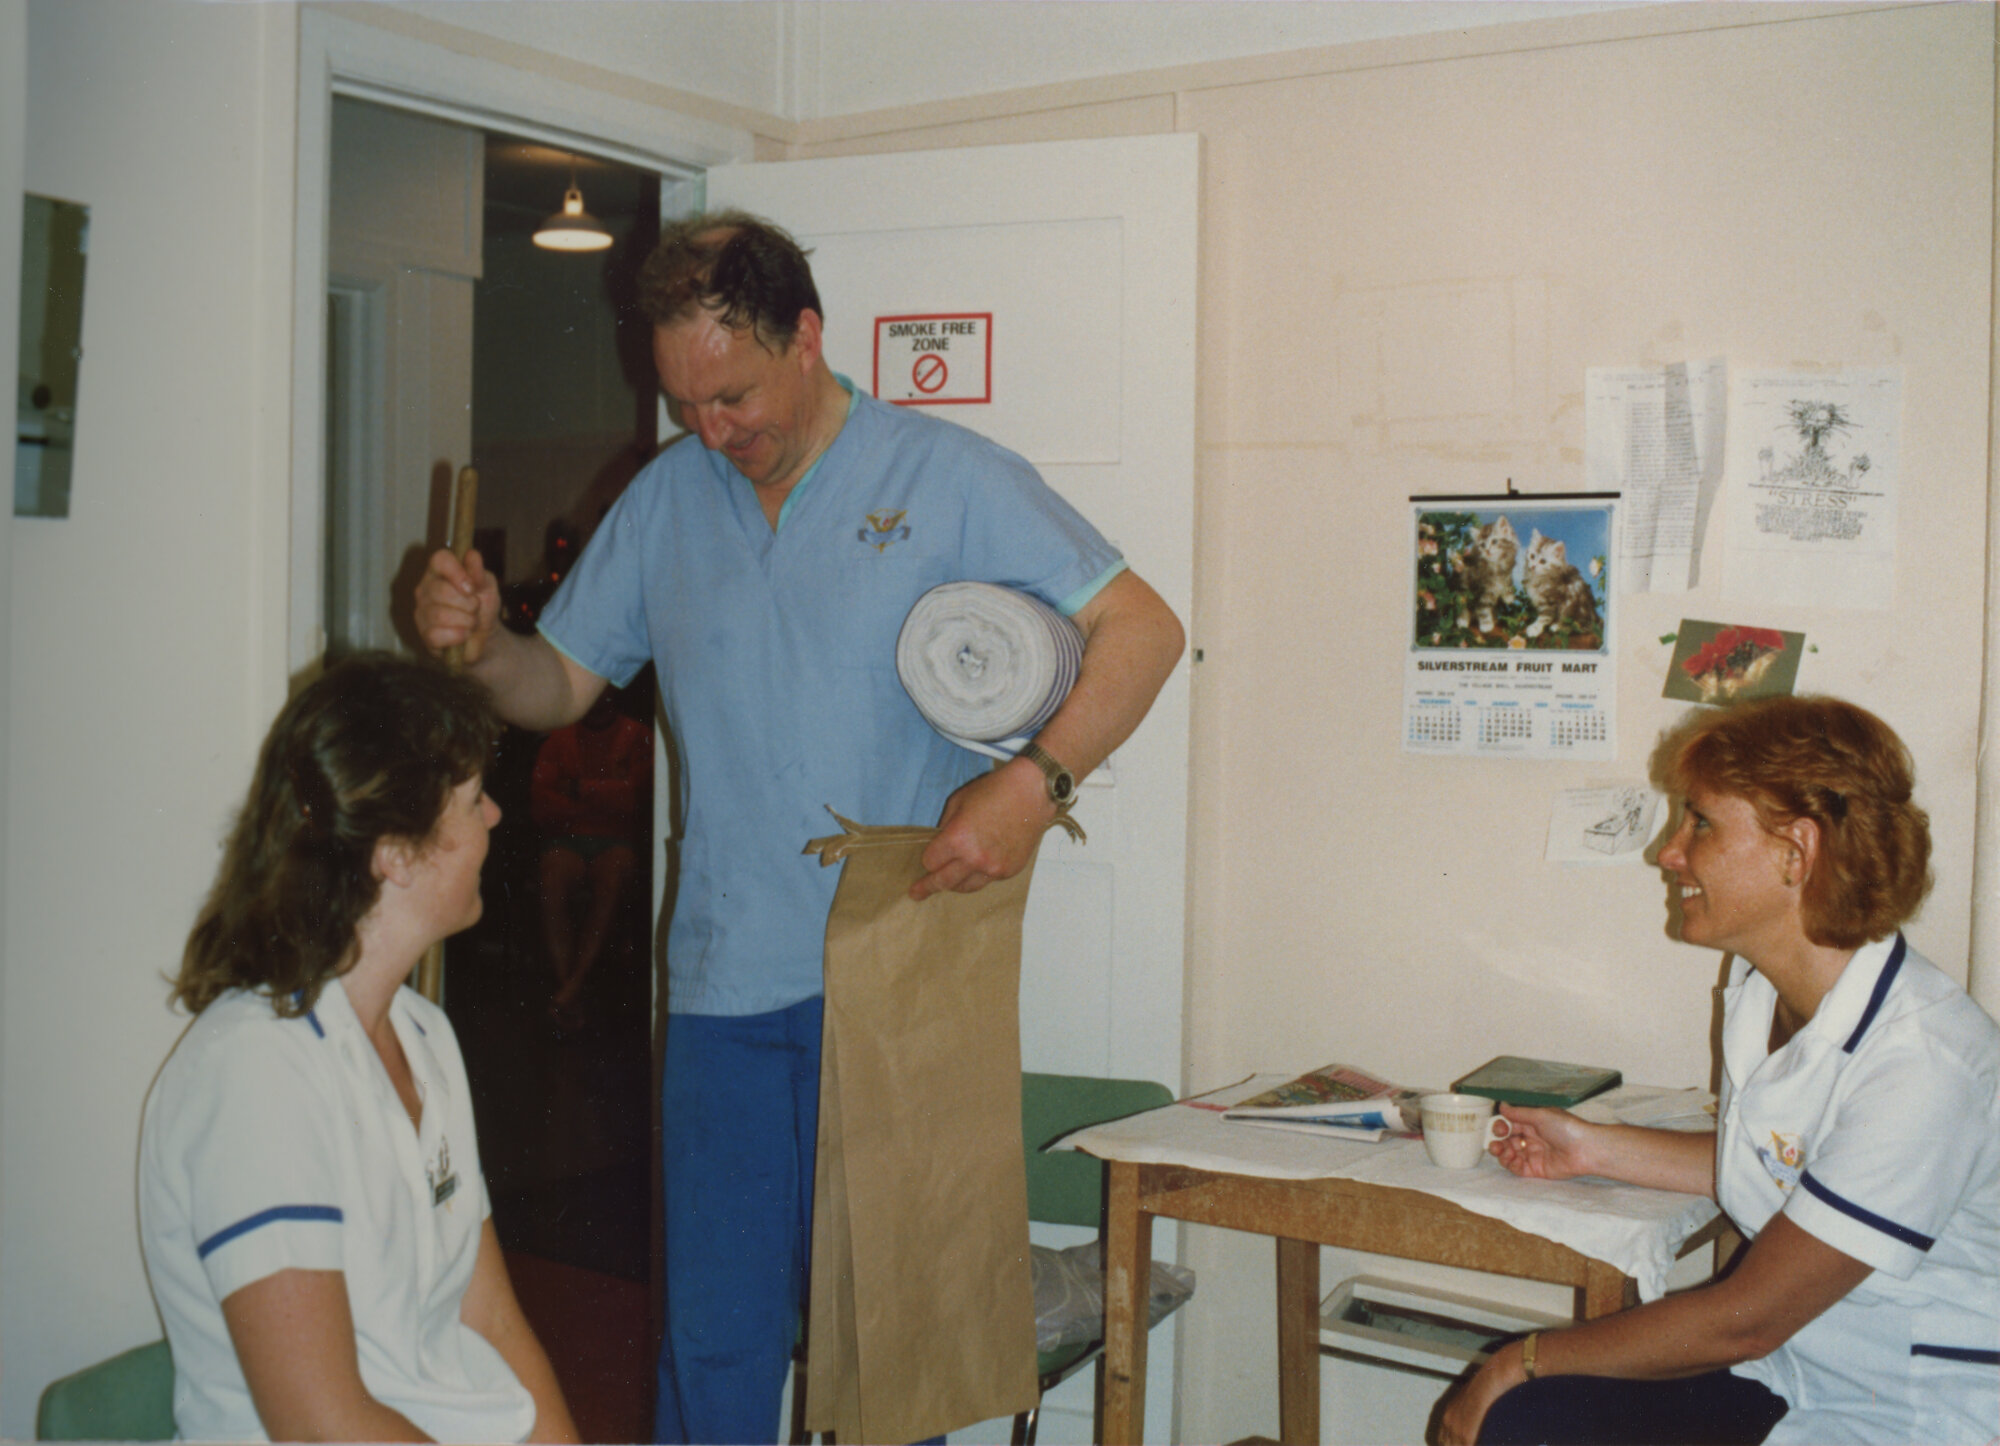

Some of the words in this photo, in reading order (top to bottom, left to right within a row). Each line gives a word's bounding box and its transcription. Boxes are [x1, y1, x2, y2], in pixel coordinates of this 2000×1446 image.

[889, 323, 937, 337] SMOKE
[941, 322, 976, 335] FREE
[912, 337, 949, 351] ZONE
[1418, 661, 1508, 672] SILVERSTREAM
[1516, 662, 1553, 673] FRUIT
[1561, 663, 1598, 674] MART
